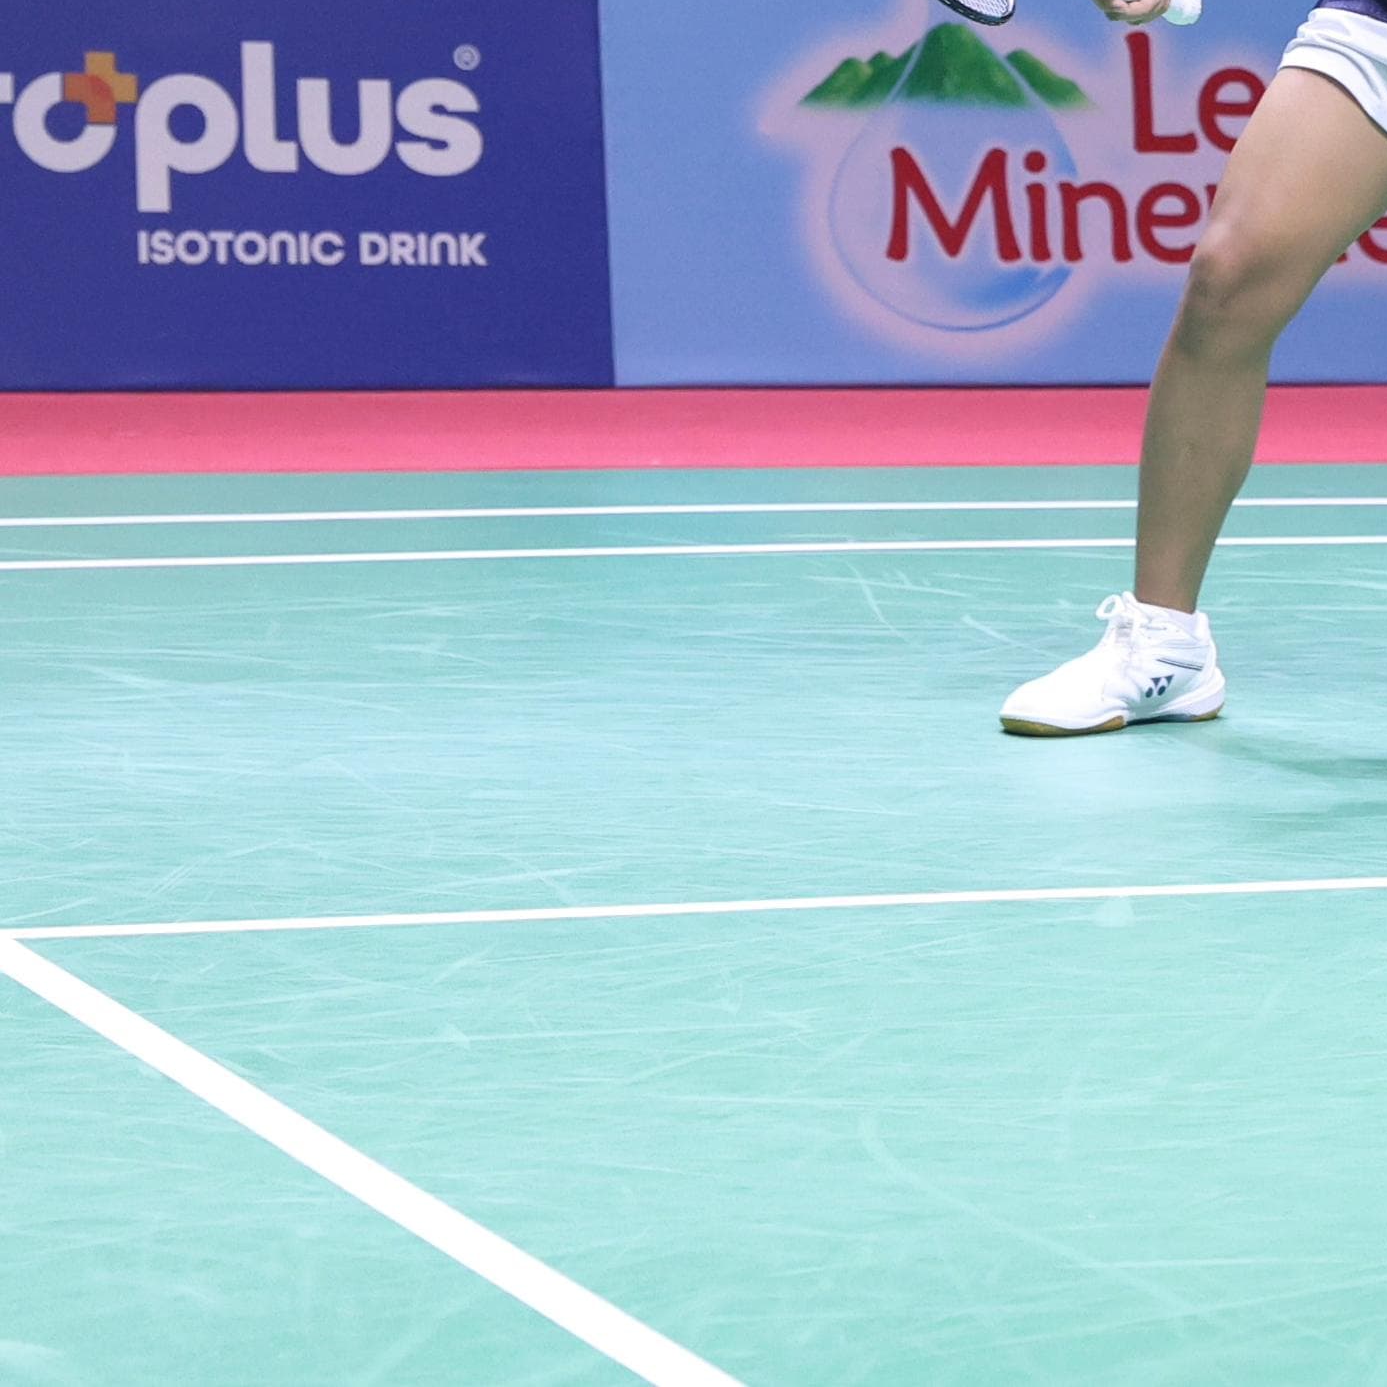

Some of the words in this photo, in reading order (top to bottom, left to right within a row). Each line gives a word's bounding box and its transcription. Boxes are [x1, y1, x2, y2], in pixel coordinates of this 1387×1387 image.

[0, 40, 484, 212] oplus
[1127, 31, 1264, 153] Le
[137, 230, 345, 267] ISOTONIC
[358, 231, 488, 267] DRINK
